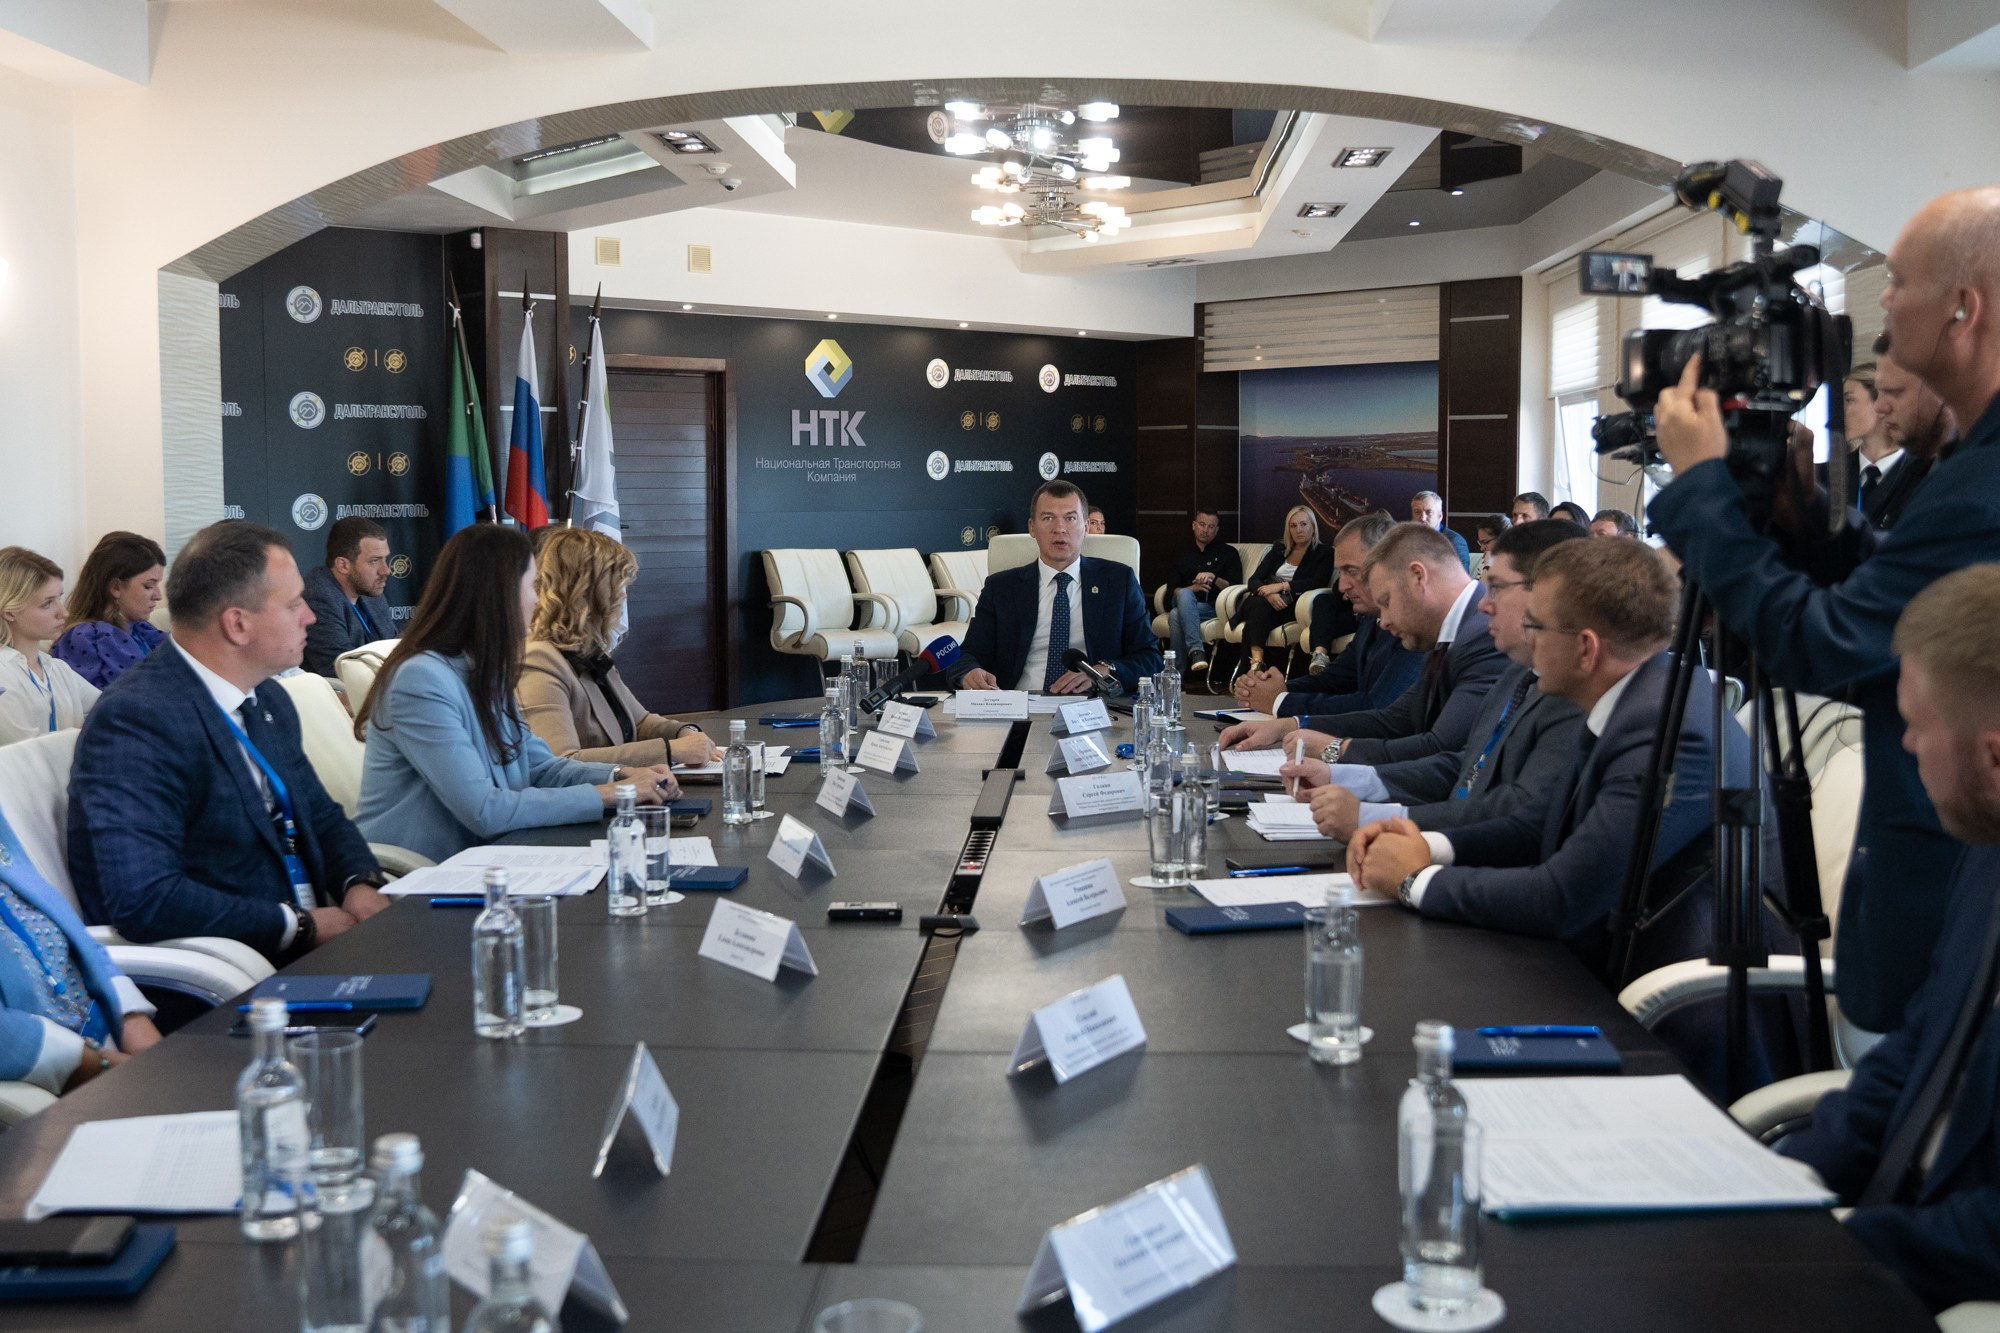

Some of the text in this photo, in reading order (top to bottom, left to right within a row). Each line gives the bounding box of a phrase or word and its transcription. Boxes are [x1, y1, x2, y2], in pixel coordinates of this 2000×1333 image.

[331, 299, 424, 317] ДАЛЬТРАНСУГОЛЬ
[954, 368, 1013, 382] ДАЛЬТРАНСУГОЛЬ
[1064, 373, 1117, 387] ДАЛЬТРАНСУГОЛЬ
[334, 404, 427, 419] ДАЛЬТРАНСУГОЛЬ
[791, 409, 867, 446] НТК
[755, 457, 901, 471] Национальная Транспортная
[954, 460, 1013, 473] ДАЛЬТРАНСУГОЛЬ
[1064, 461, 1117, 474] ДАЛЬТРАНСУГОЛЬ
[807, 471, 857, 482] Компания
[336, 504, 429, 520] ДАЛЬТРАНСУГОЛЬ
